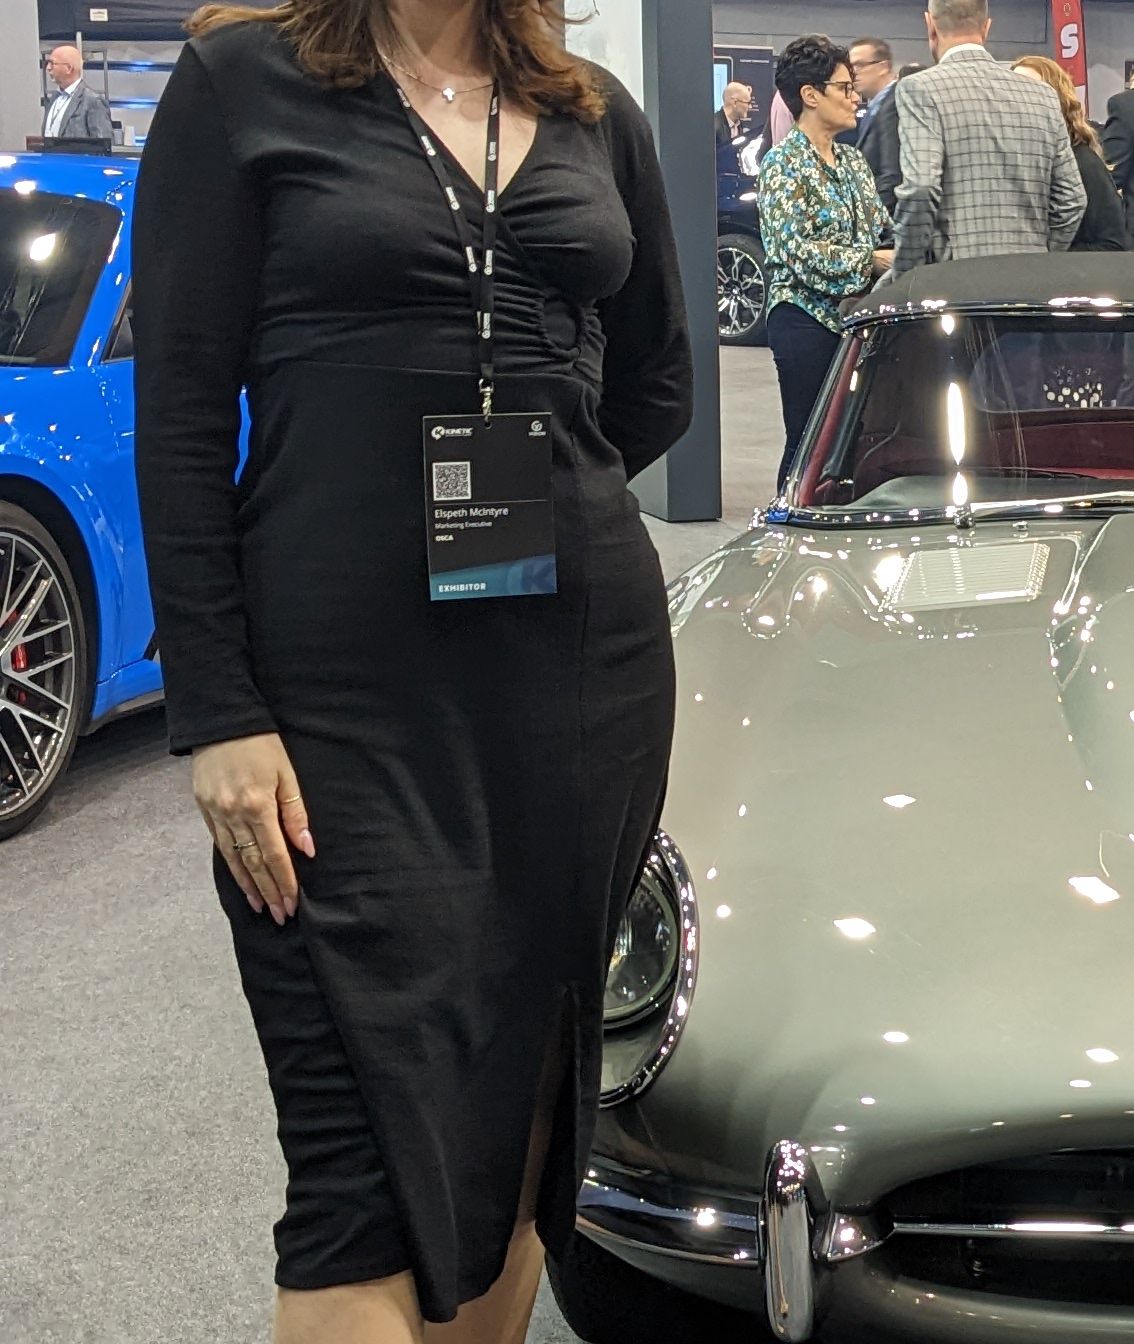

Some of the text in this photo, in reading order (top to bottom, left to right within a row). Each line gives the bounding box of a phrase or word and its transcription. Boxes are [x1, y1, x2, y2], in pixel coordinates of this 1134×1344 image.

[434, 508, 509, 519] Elspeth McIntyre
[438, 582, 486, 592] EXHIBITOR
